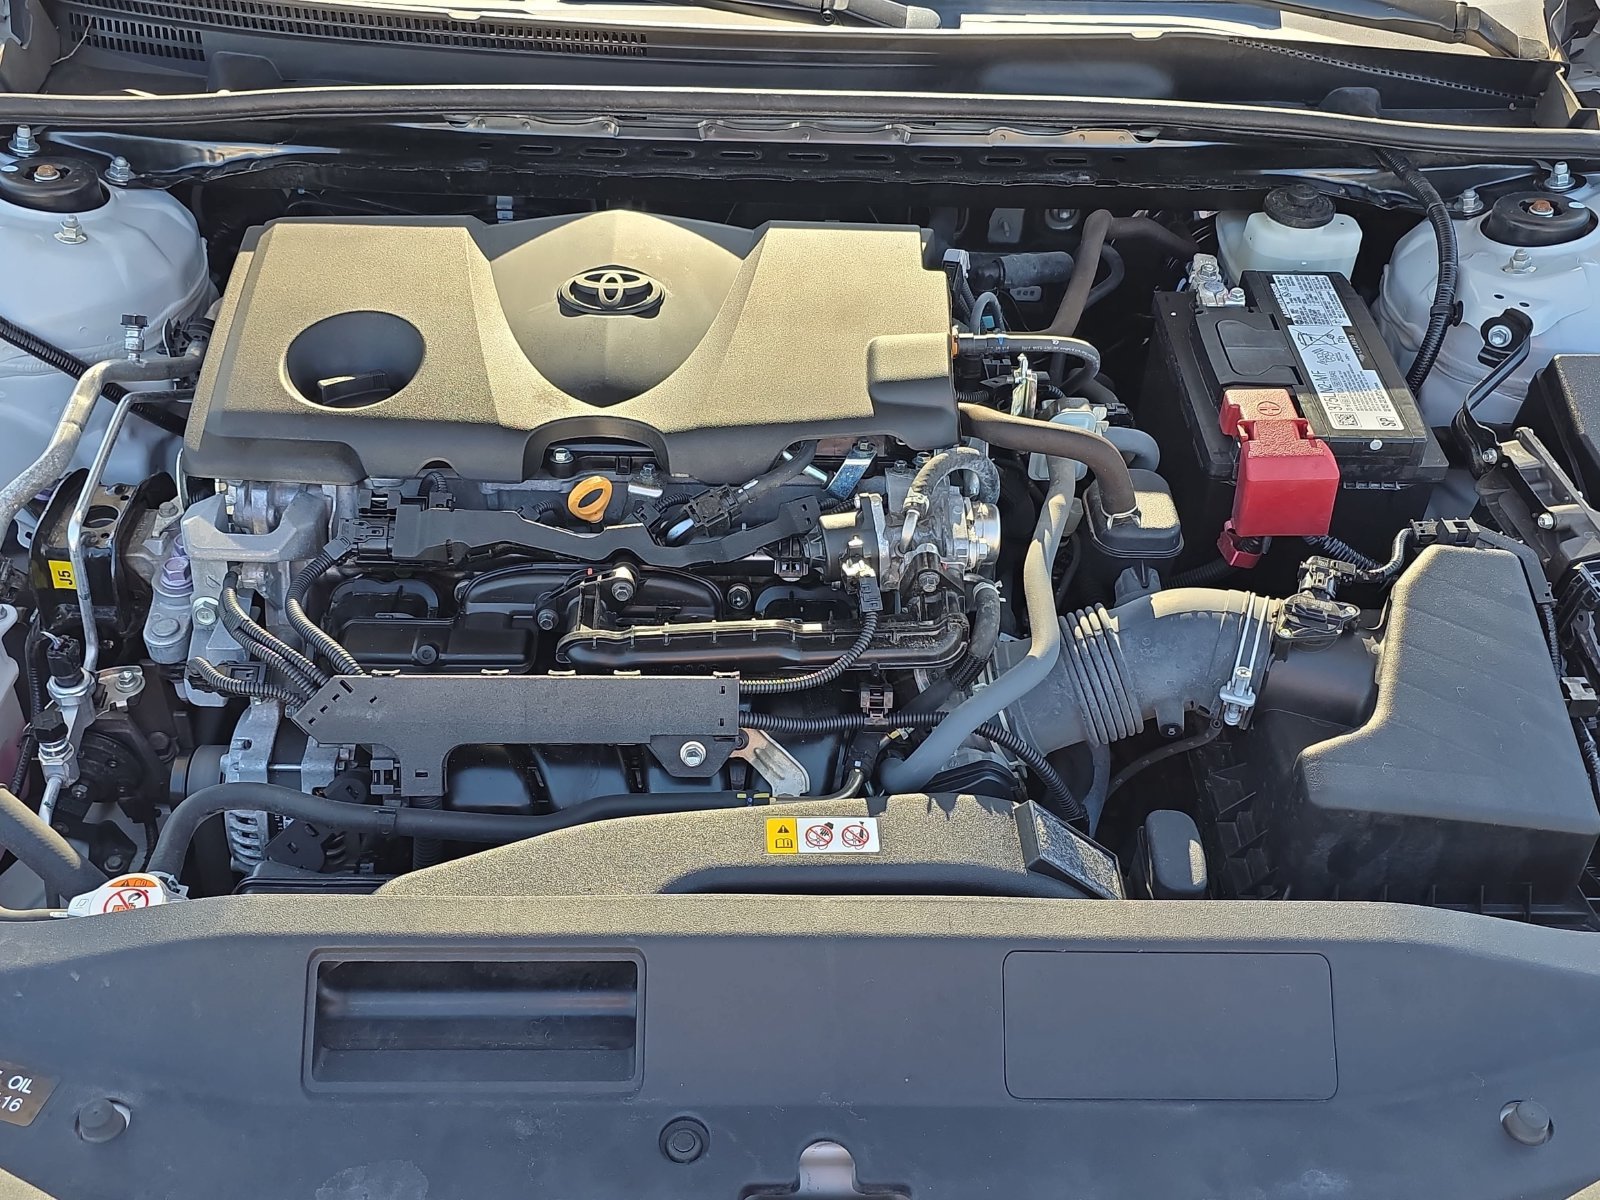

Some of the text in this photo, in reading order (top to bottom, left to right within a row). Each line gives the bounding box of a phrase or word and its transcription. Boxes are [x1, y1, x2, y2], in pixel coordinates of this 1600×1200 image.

[1311, 370, 1343, 411] 375LN2-MF
[1379, 417, 1397, 427] SP
[57, 570, 73, 586] J5
[8, 1075, 33, 1095] OIL
[0, 1093, 24, 1112] 16
